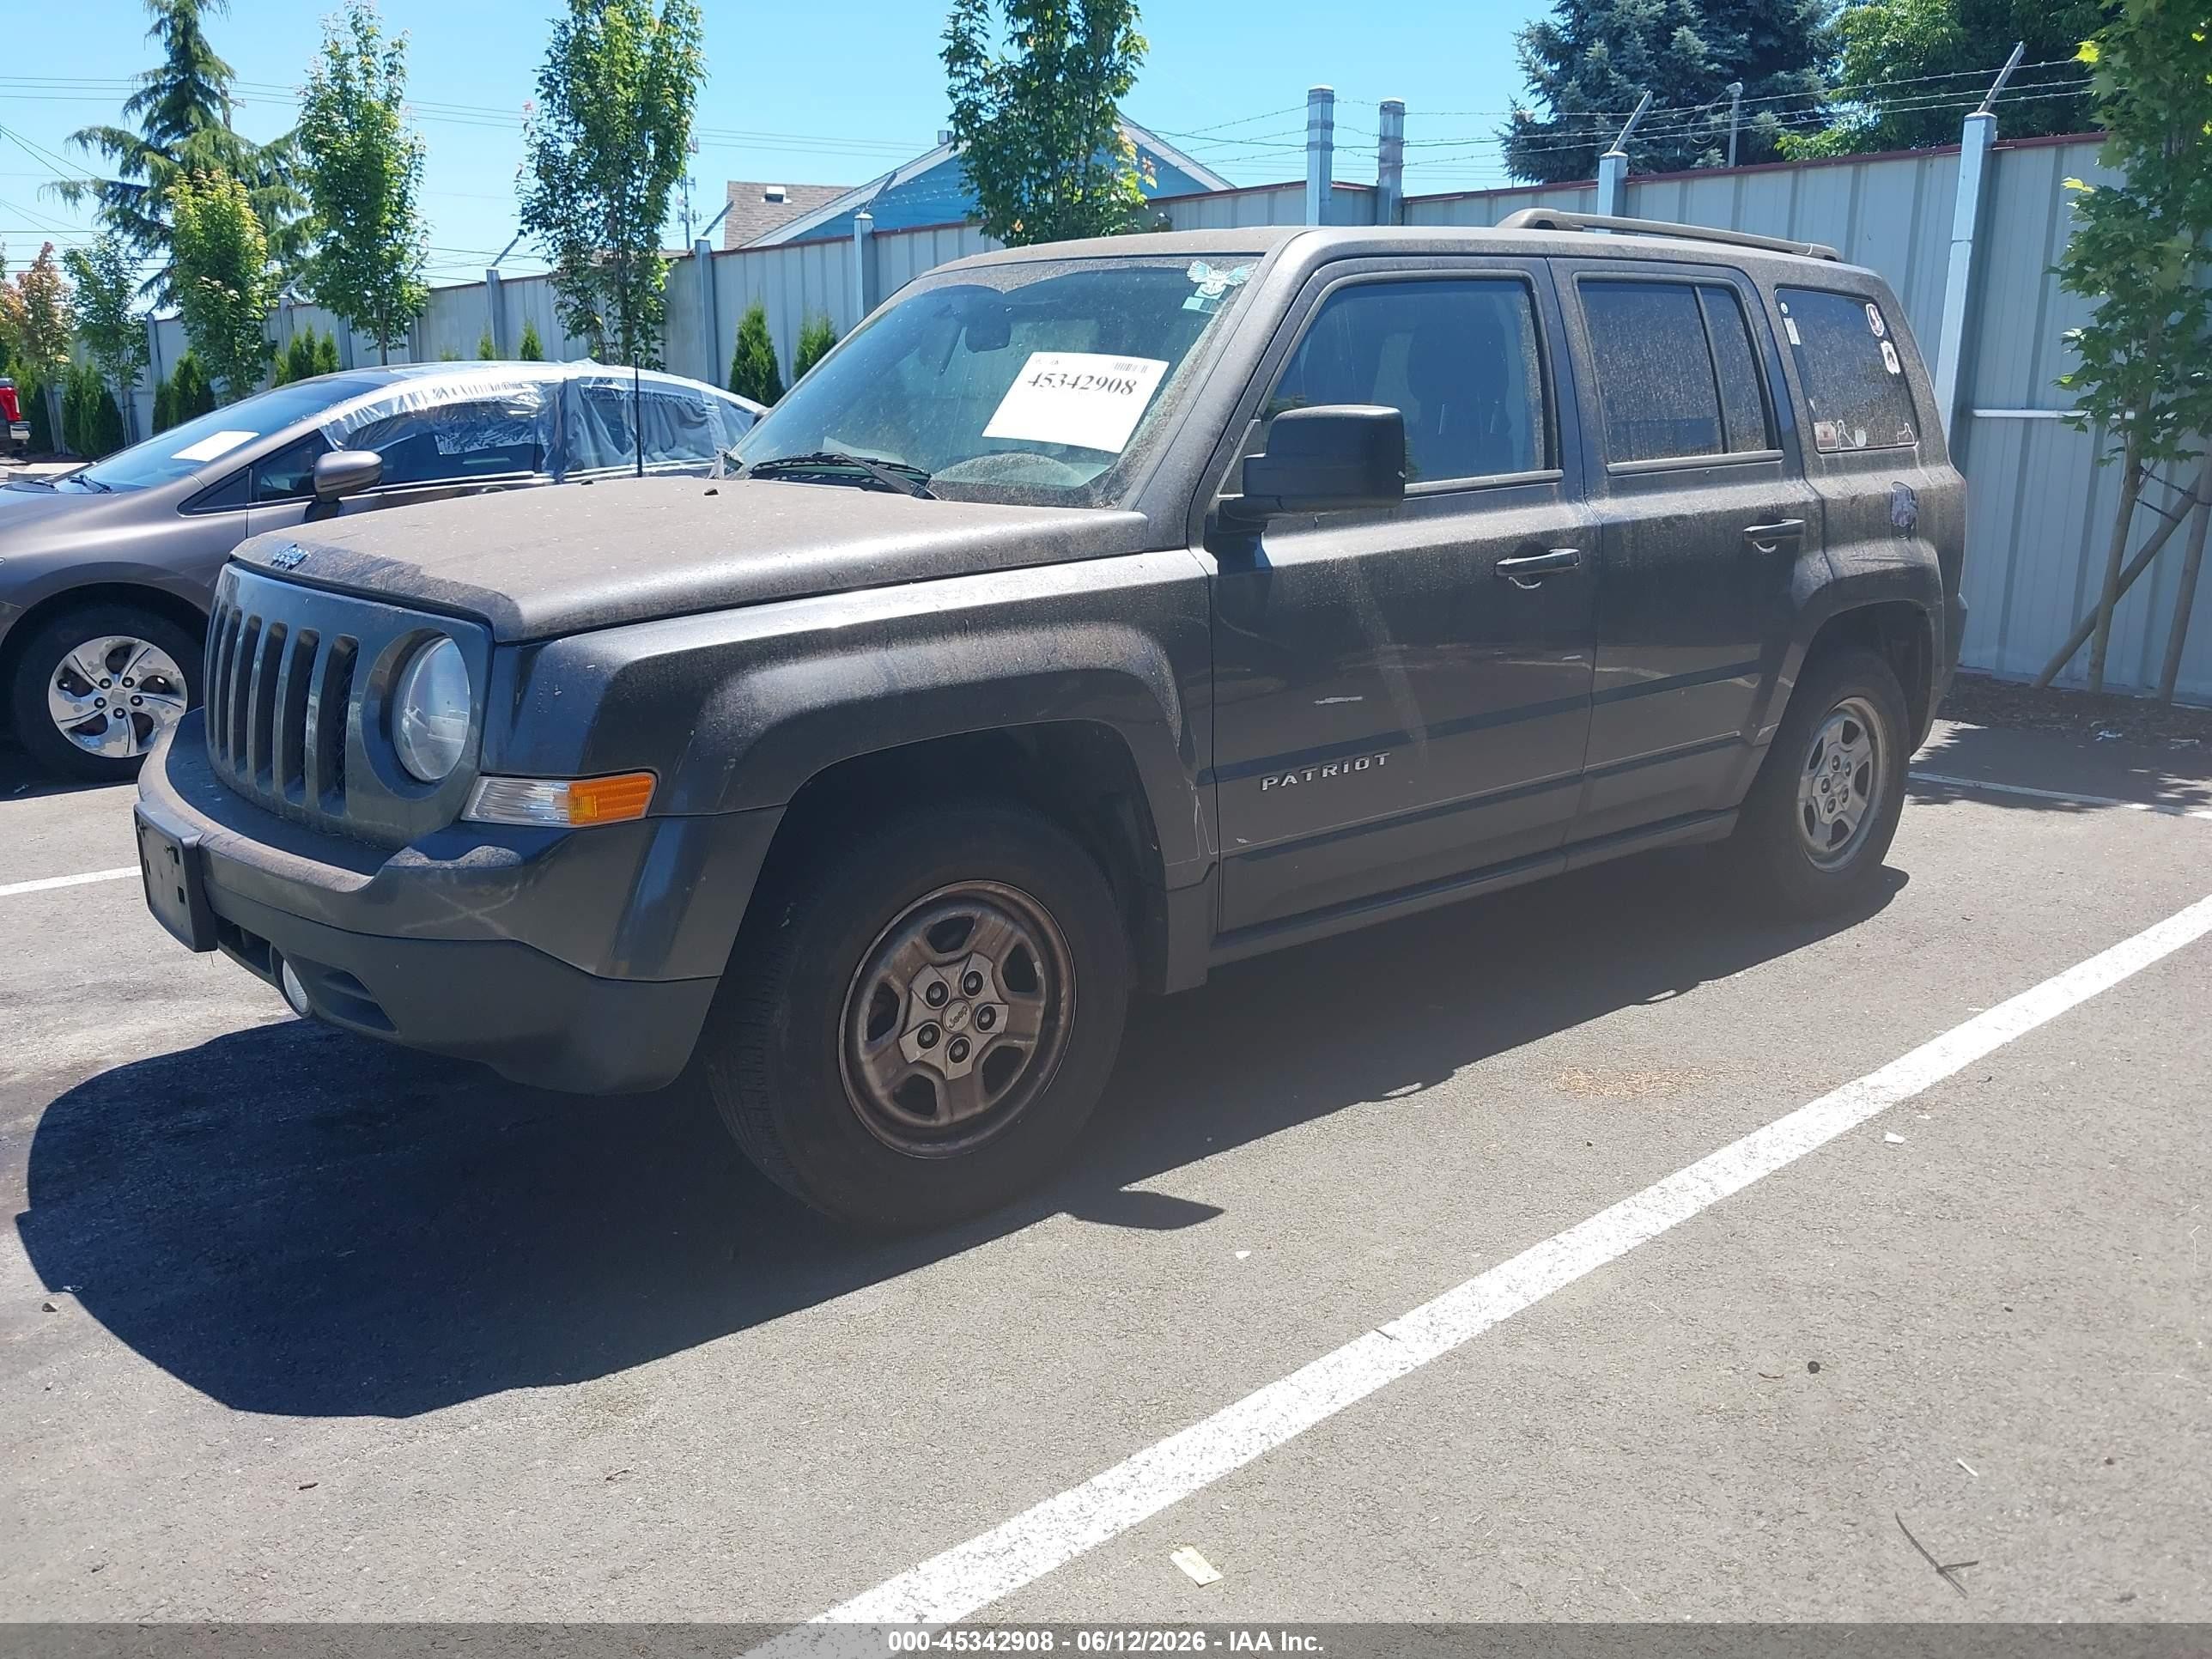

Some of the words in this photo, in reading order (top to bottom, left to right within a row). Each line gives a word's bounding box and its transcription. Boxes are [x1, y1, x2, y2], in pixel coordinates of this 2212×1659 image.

[1027, 371, 1138, 396] 45342908
[1261, 751, 1391, 791] PATRIOT
[948, 1005, 969, 1029] Jeep
